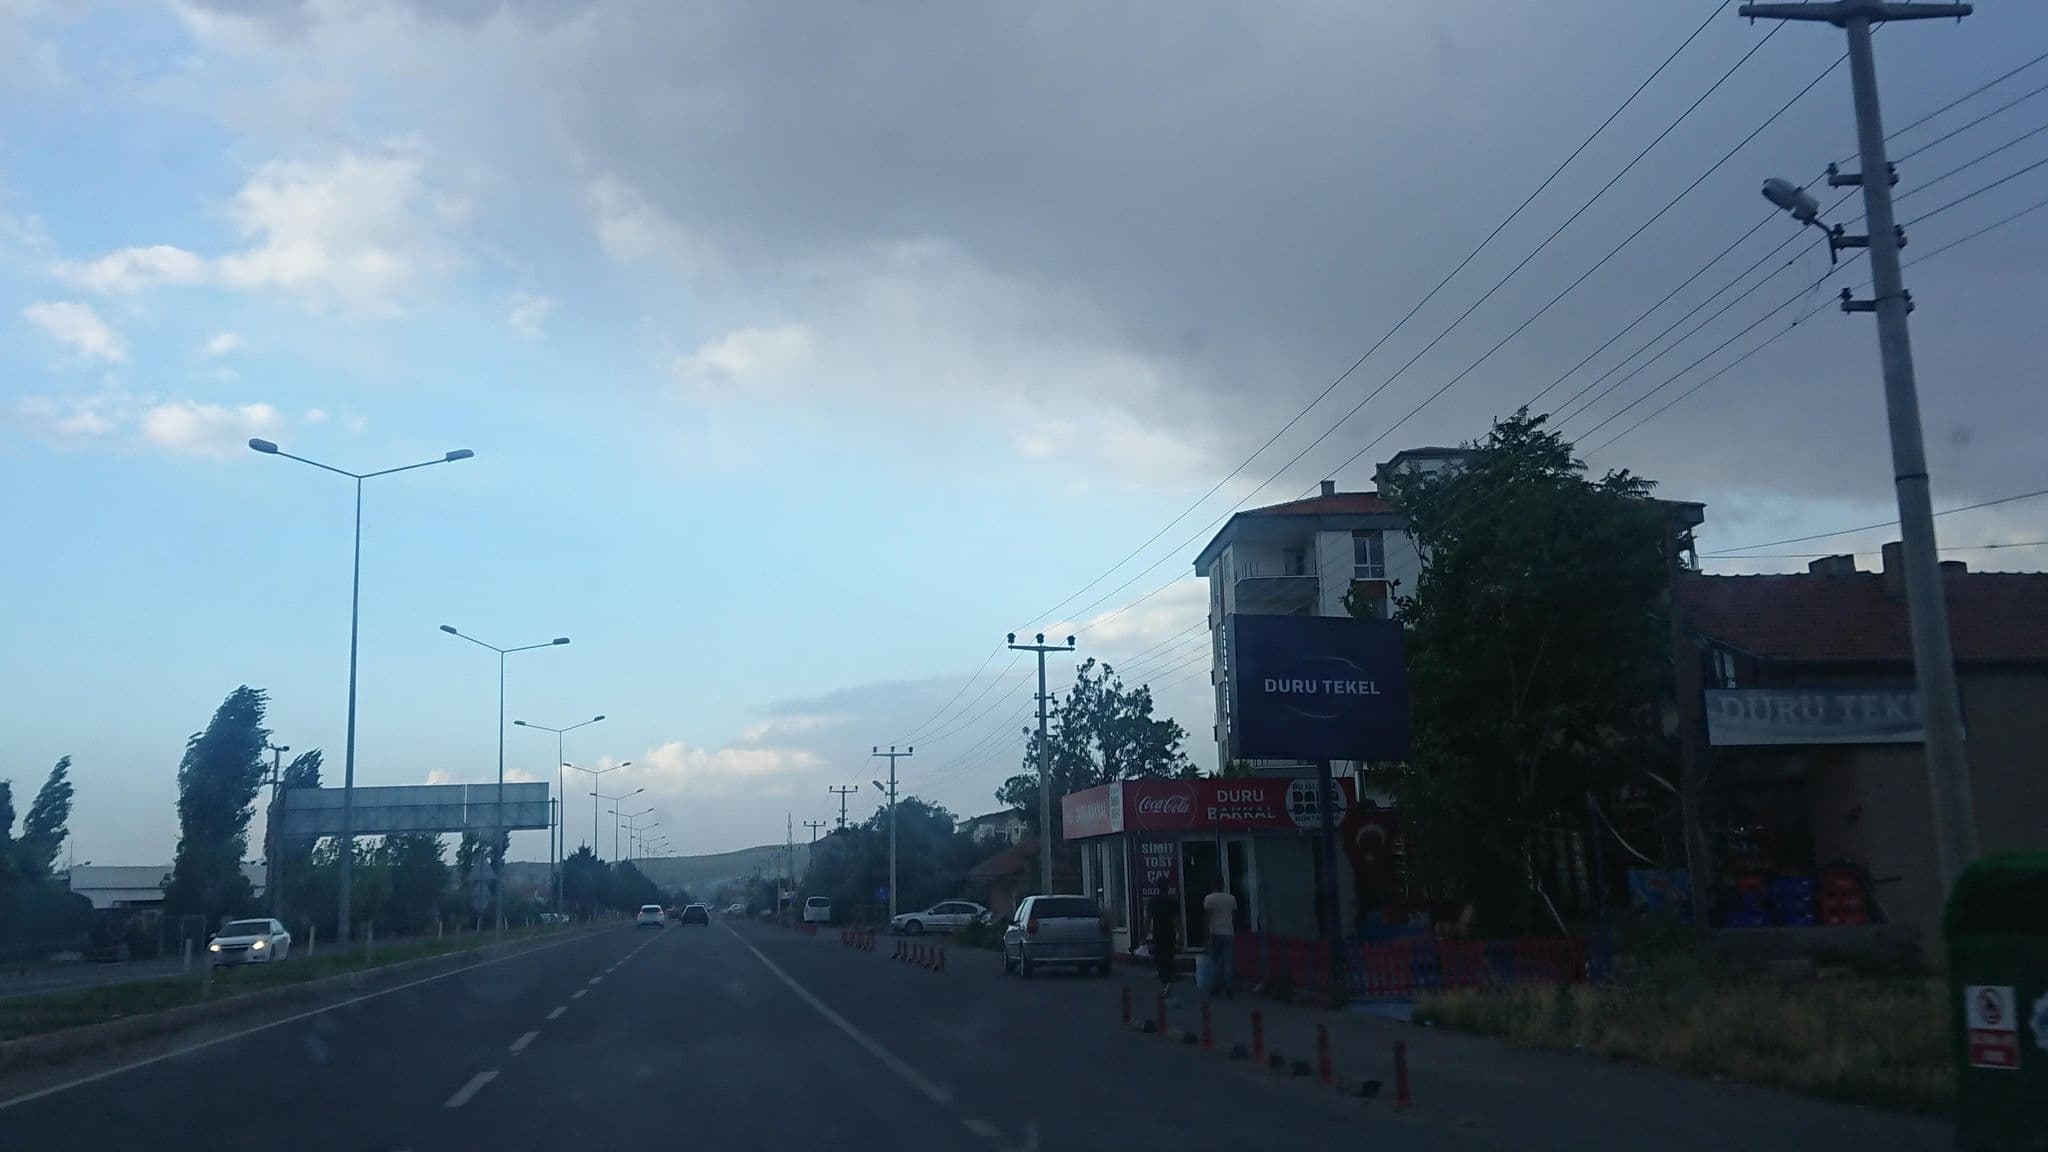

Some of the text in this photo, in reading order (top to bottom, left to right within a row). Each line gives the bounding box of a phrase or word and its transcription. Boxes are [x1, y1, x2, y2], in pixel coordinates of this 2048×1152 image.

[1264, 679, 1381, 695] DURU TEKEL
[1720, 696, 1825, 719] DURU
[1216, 789, 1265, 803] DURU
[1207, 806, 1277, 820] BAKKAL
[1144, 856, 1173, 867] TOST
